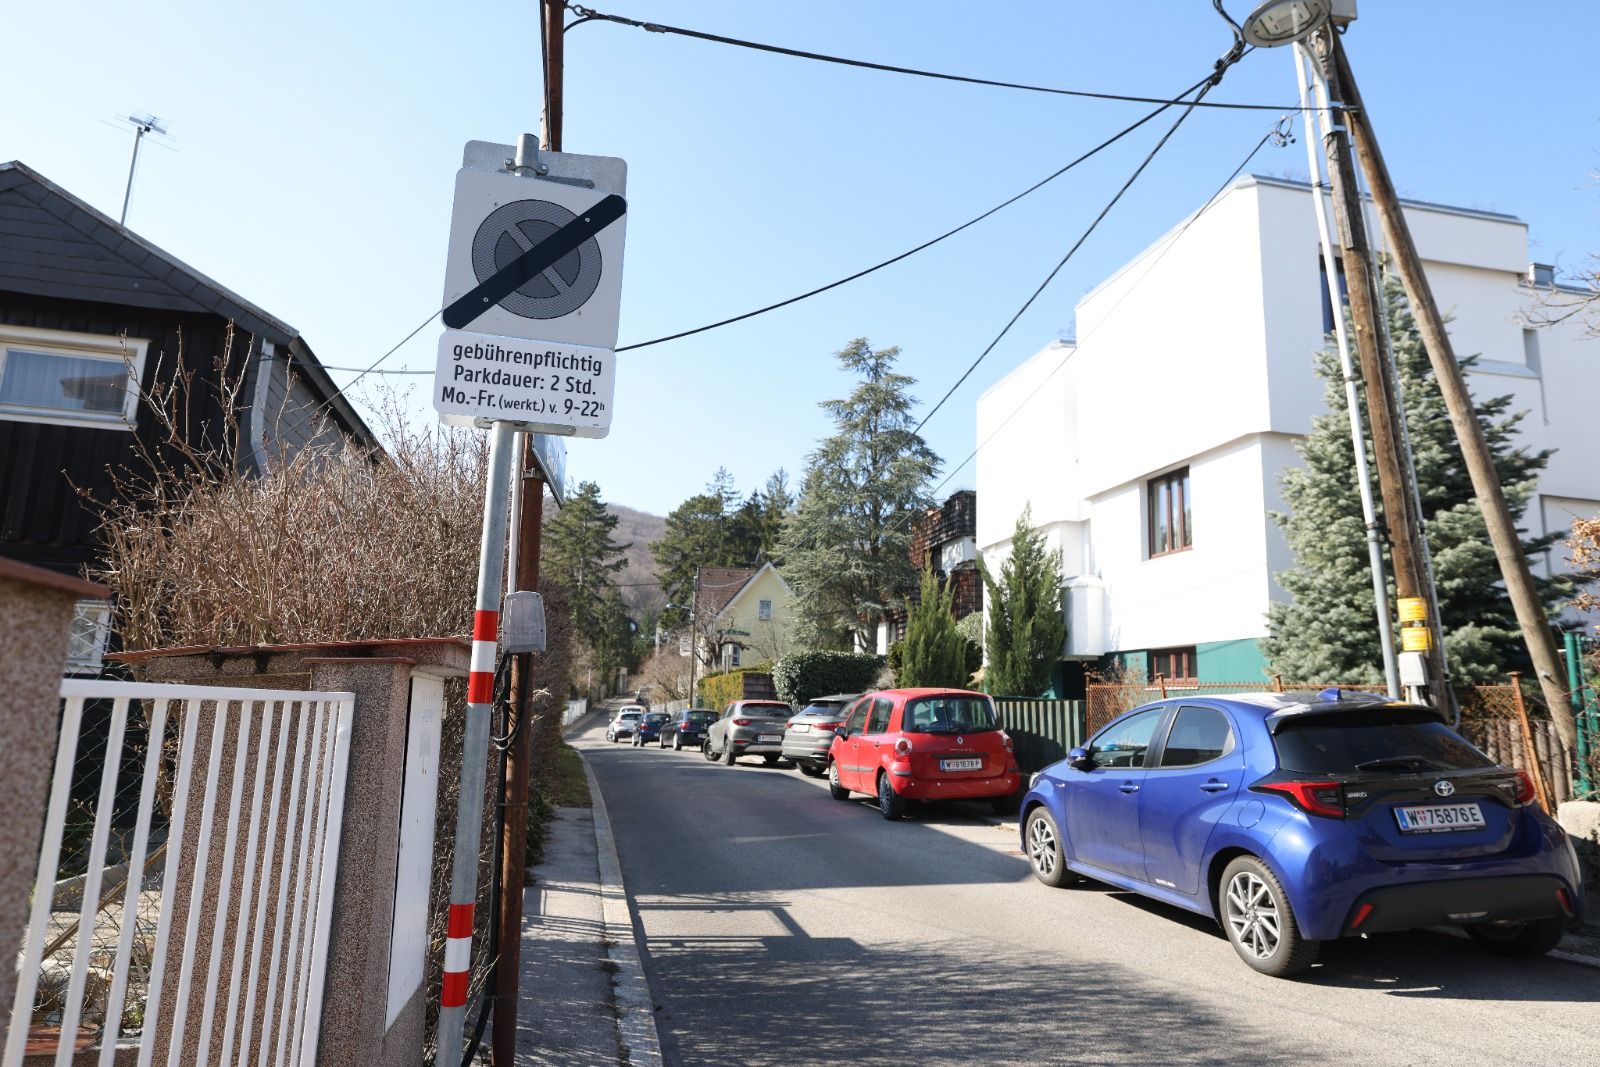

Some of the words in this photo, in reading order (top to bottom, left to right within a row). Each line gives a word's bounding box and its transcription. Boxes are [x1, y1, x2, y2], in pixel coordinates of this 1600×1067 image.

[453, 343, 602, 376] gebührenpflichtig
[454, 364, 545, 389] Parkdauer:
[550, 375, 560, 391] 2
[565, 376, 596, 395] Std.
[441, 386, 496, 408] Mo.-Fr.
[498, 394, 545, 413] (werkt.)
[549, 403, 558, 414] v.
